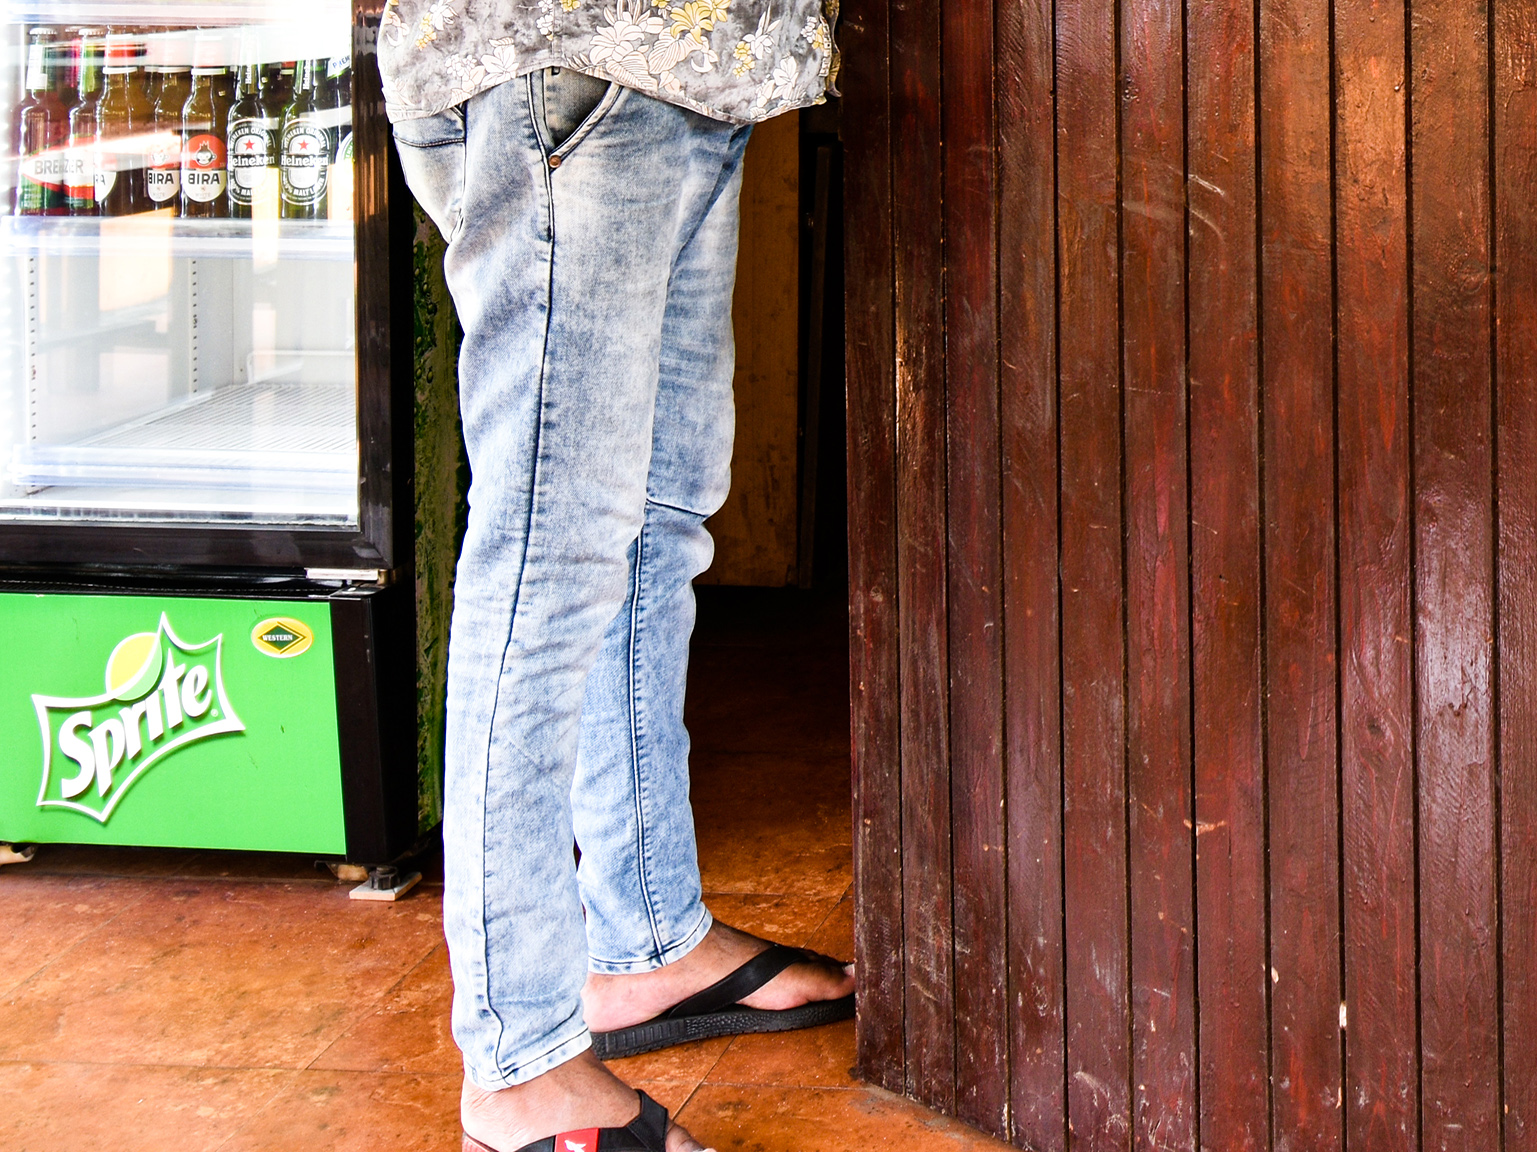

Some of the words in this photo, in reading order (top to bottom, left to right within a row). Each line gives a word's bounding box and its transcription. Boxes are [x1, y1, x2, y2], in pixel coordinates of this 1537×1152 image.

[228, 154, 275, 166] Heineken
[281, 154, 328, 166] Heineken
[188, 173, 220, 184] BIRA
[58, 647, 212, 799] Sprite
